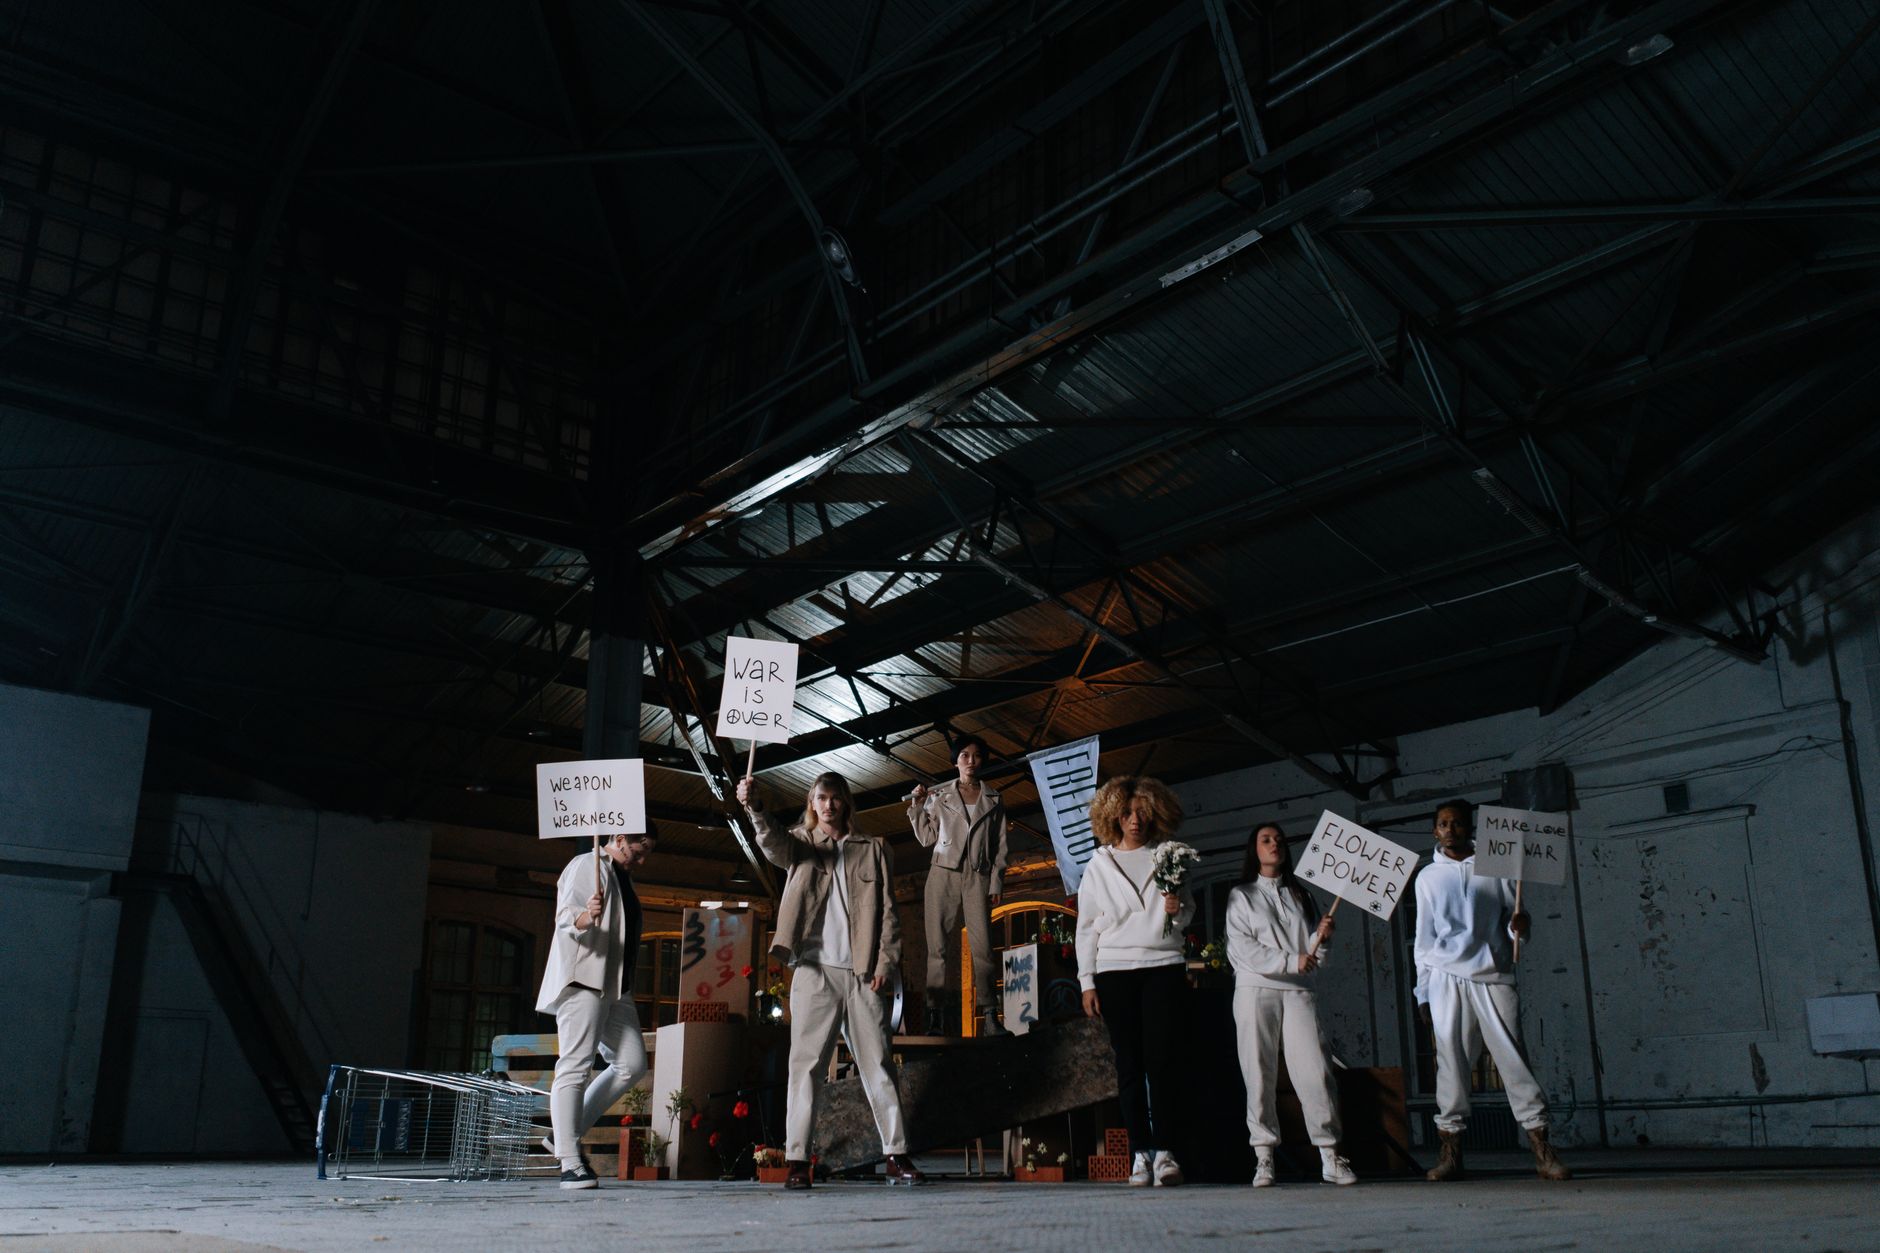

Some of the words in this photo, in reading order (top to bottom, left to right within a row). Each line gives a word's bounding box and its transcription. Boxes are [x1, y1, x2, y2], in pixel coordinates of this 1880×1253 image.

[744, 686, 764, 704] is
[553, 796, 568, 811] is
[1321, 822, 1405, 876] FLOWER
[1488, 839, 1517, 857] NOT
[1523, 843, 1558, 861] WAR
[1321, 852, 1397, 903] POWER
